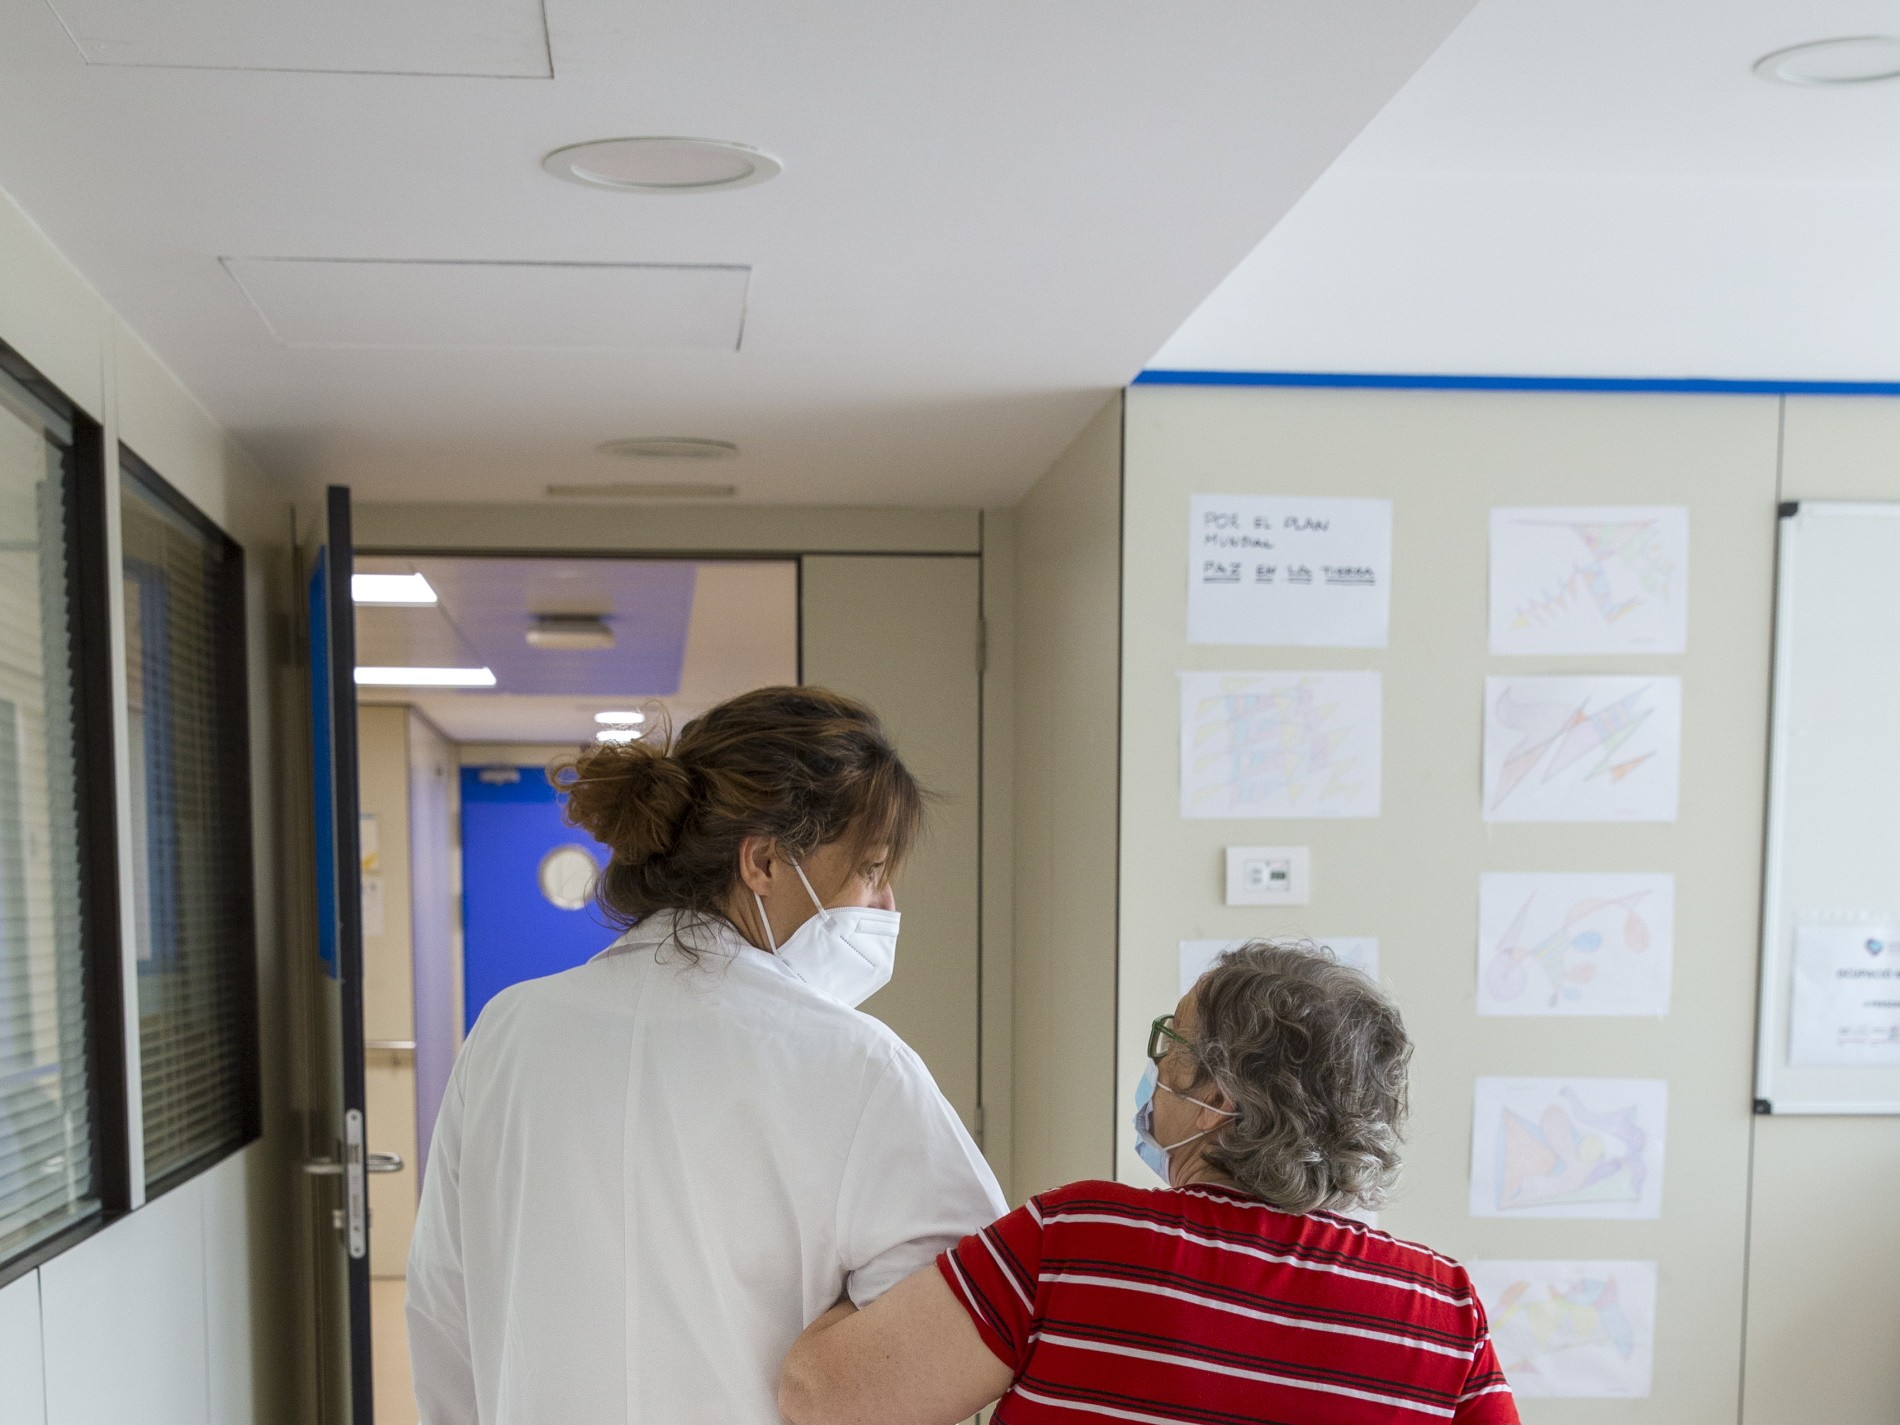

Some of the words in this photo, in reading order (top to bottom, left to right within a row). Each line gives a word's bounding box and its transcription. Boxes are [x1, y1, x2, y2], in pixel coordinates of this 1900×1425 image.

[1203, 511, 1240, 530] POR
[1253, 515, 1272, 530] EL
[1283, 515, 1330, 532] PLAN
[1203, 560, 1241, 578] PAZ
[1255, 563, 1277, 577] EN
[1287, 563, 1313, 578] LA
